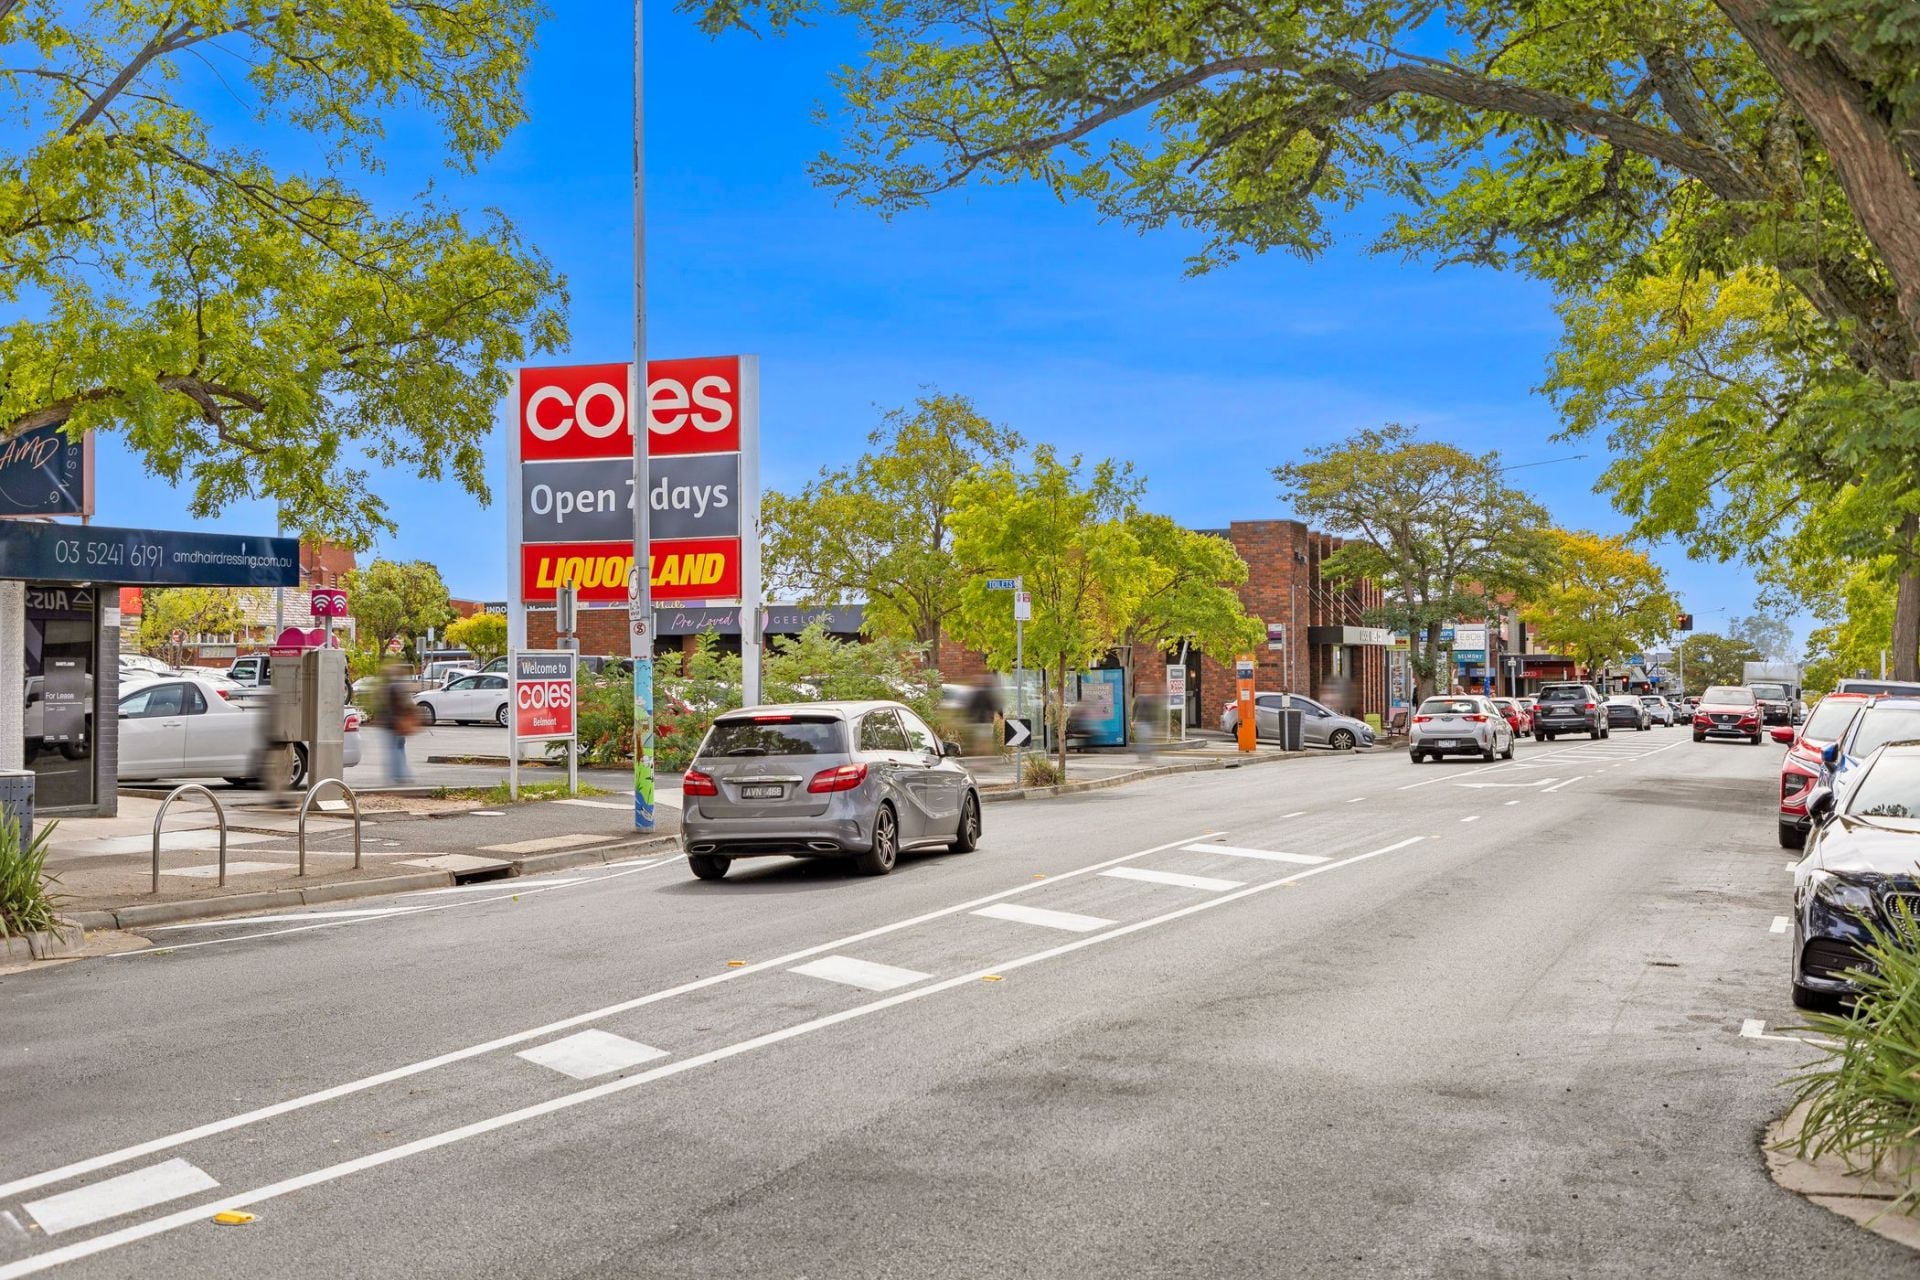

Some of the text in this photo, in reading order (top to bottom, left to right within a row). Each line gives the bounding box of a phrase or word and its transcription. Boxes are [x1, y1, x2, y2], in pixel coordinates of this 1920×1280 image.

[526, 364, 733, 441] coles
[530, 484, 615, 523] Open
[650, 477, 729, 518] days
[55, 540, 292, 569] 03 5241 6191 amdhairdressing.com.au
[671, 613, 694, 630] Pre
[522, 662, 567, 674] Welcome to
[45, 692, 56, 700] For
[518, 682, 571, 709] coles
[533, 717, 557, 726] Belmont
